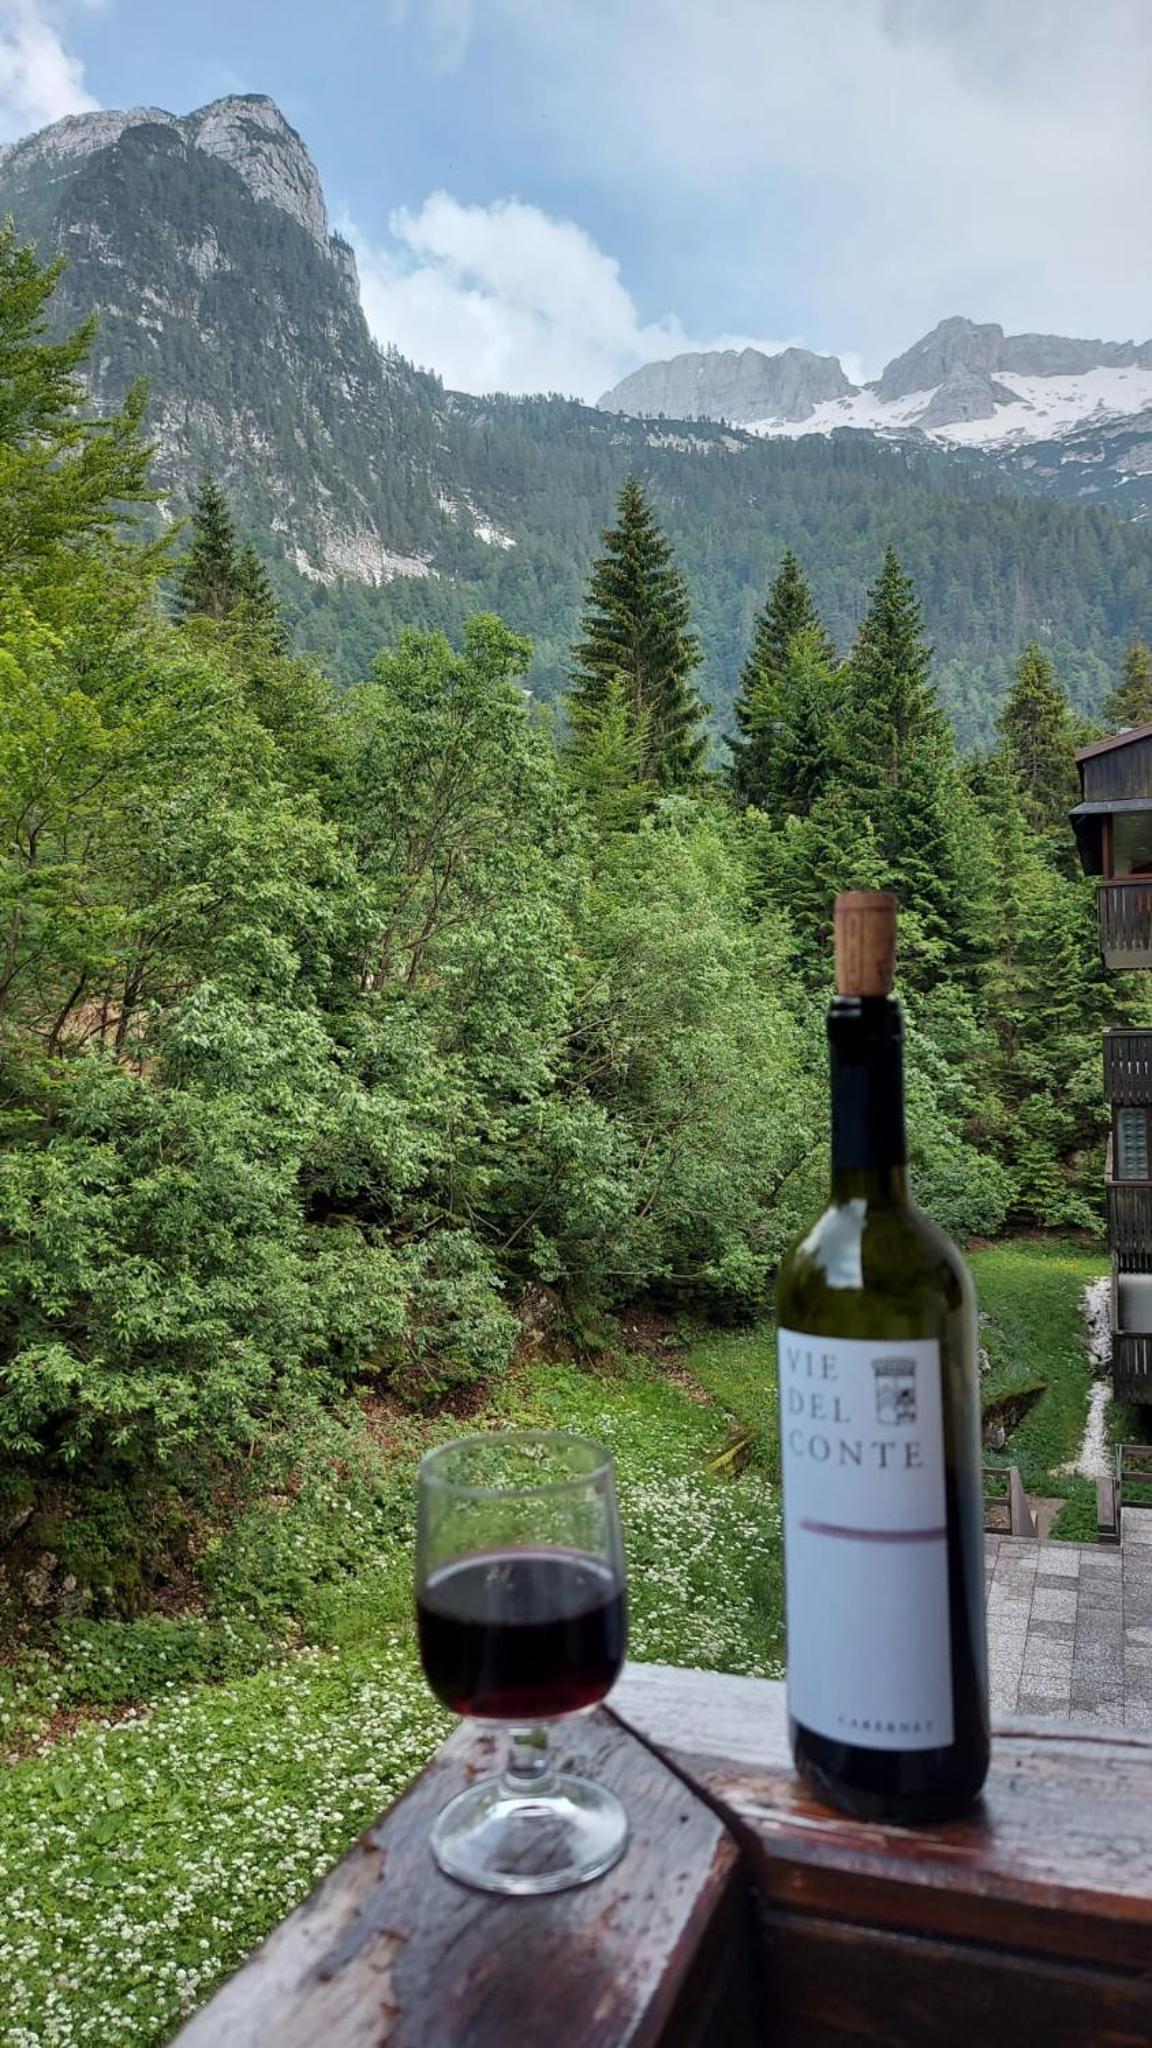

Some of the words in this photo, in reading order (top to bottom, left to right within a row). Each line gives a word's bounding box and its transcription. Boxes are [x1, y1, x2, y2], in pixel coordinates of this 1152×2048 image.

[786, 1347, 838, 1381] VIE
[788, 1386, 851, 1423] DEL
[788, 1429, 924, 1469] CONTE
